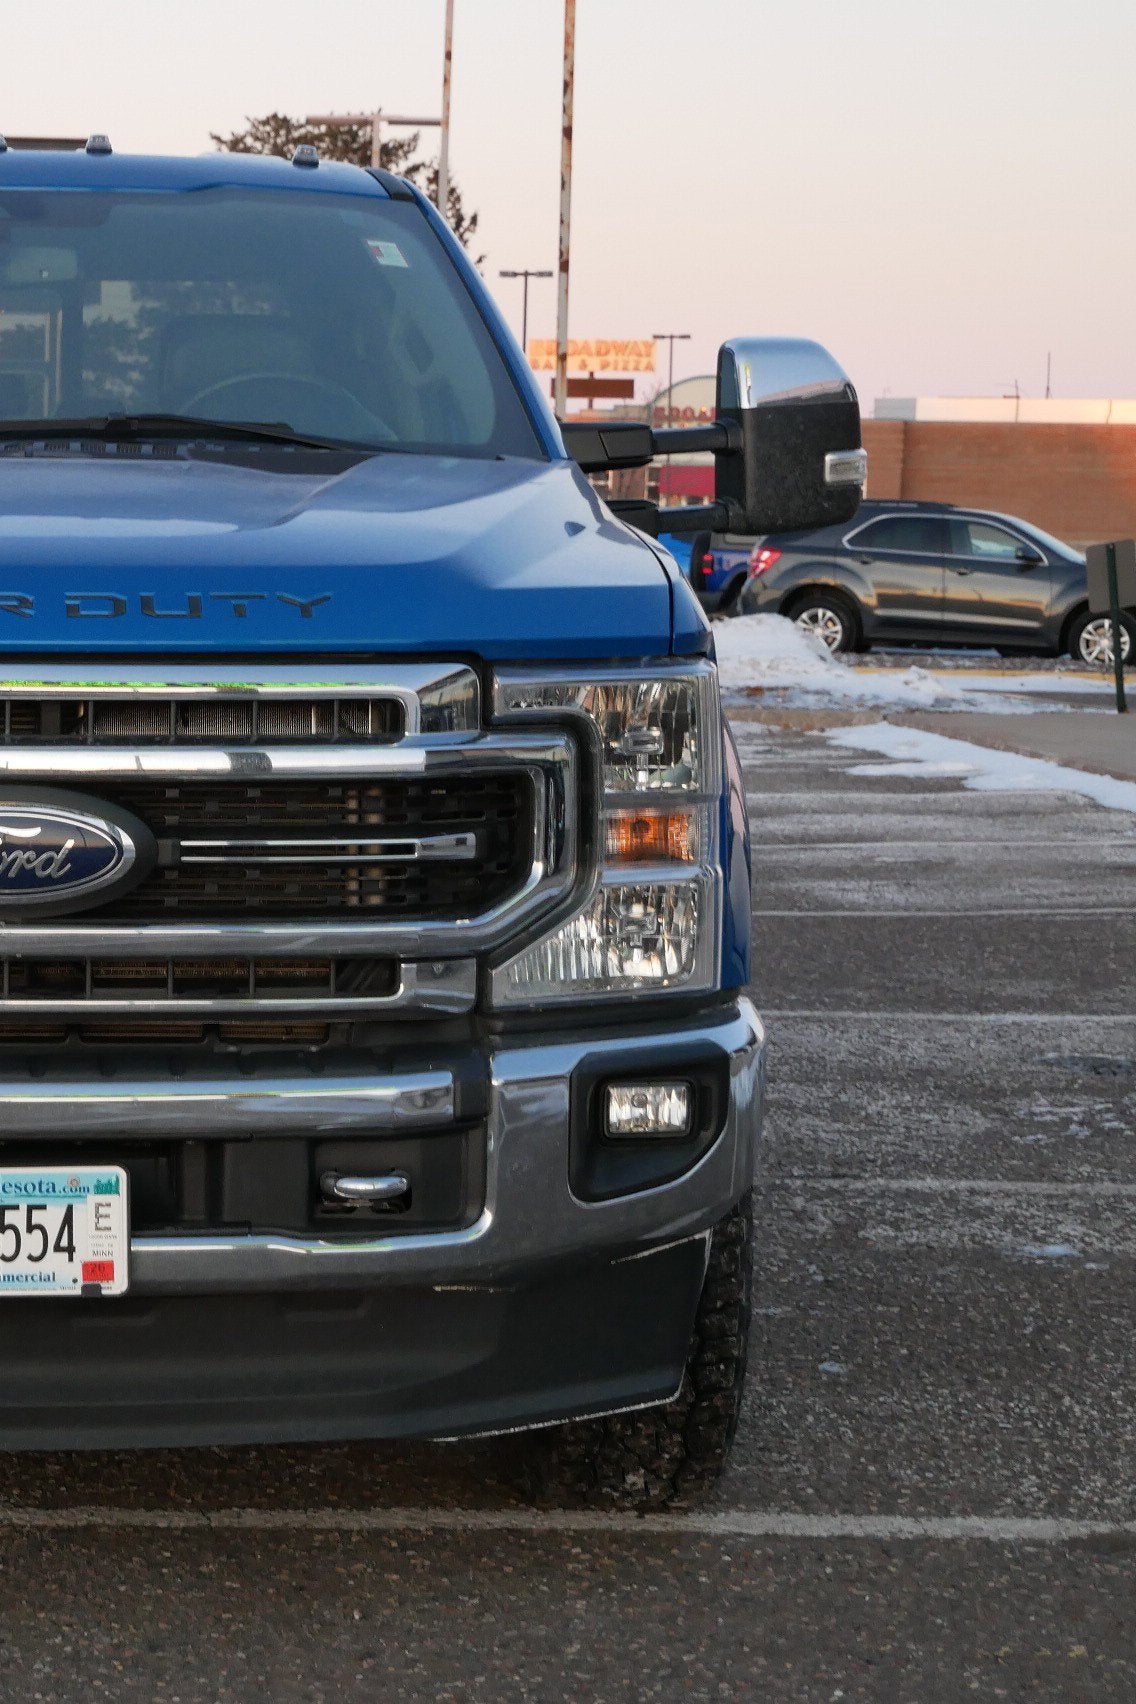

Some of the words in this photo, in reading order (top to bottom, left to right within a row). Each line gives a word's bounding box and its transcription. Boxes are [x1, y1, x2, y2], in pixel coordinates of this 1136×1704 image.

[599, 360, 655, 371] PIZZA
[64, 591, 333, 618] DUTY
[94, 1202, 112, 1231] E
